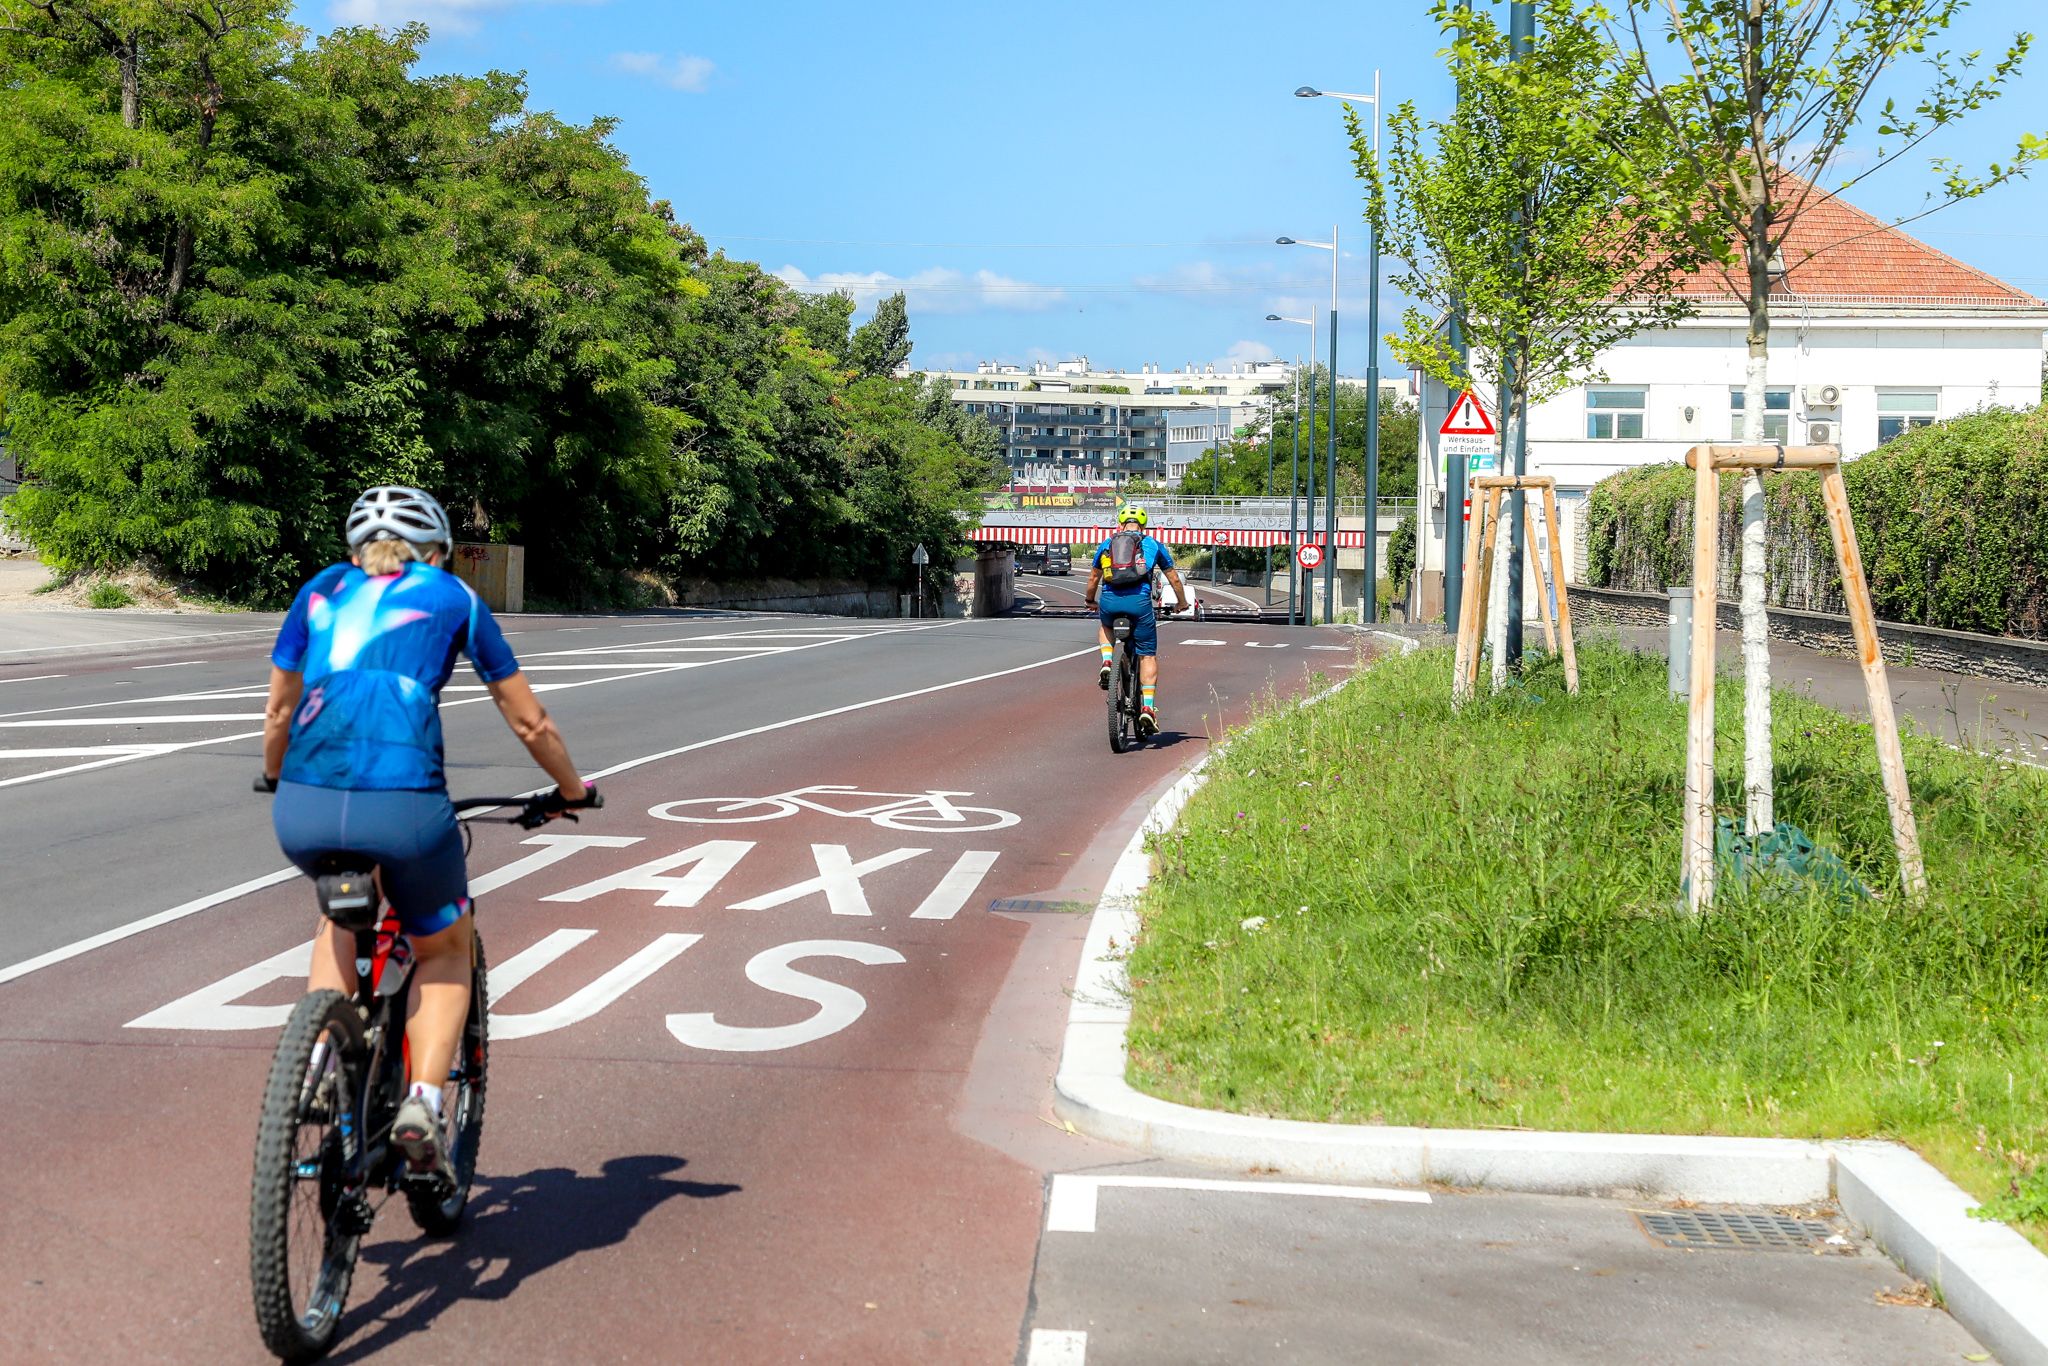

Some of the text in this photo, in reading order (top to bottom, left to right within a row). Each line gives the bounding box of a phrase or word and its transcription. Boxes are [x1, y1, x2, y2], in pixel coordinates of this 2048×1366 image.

[1447, 436, 1486, 444] Werksaus-
[1022, 497, 1052, 506] BILLA
[467, 833, 999, 920] TAXI
